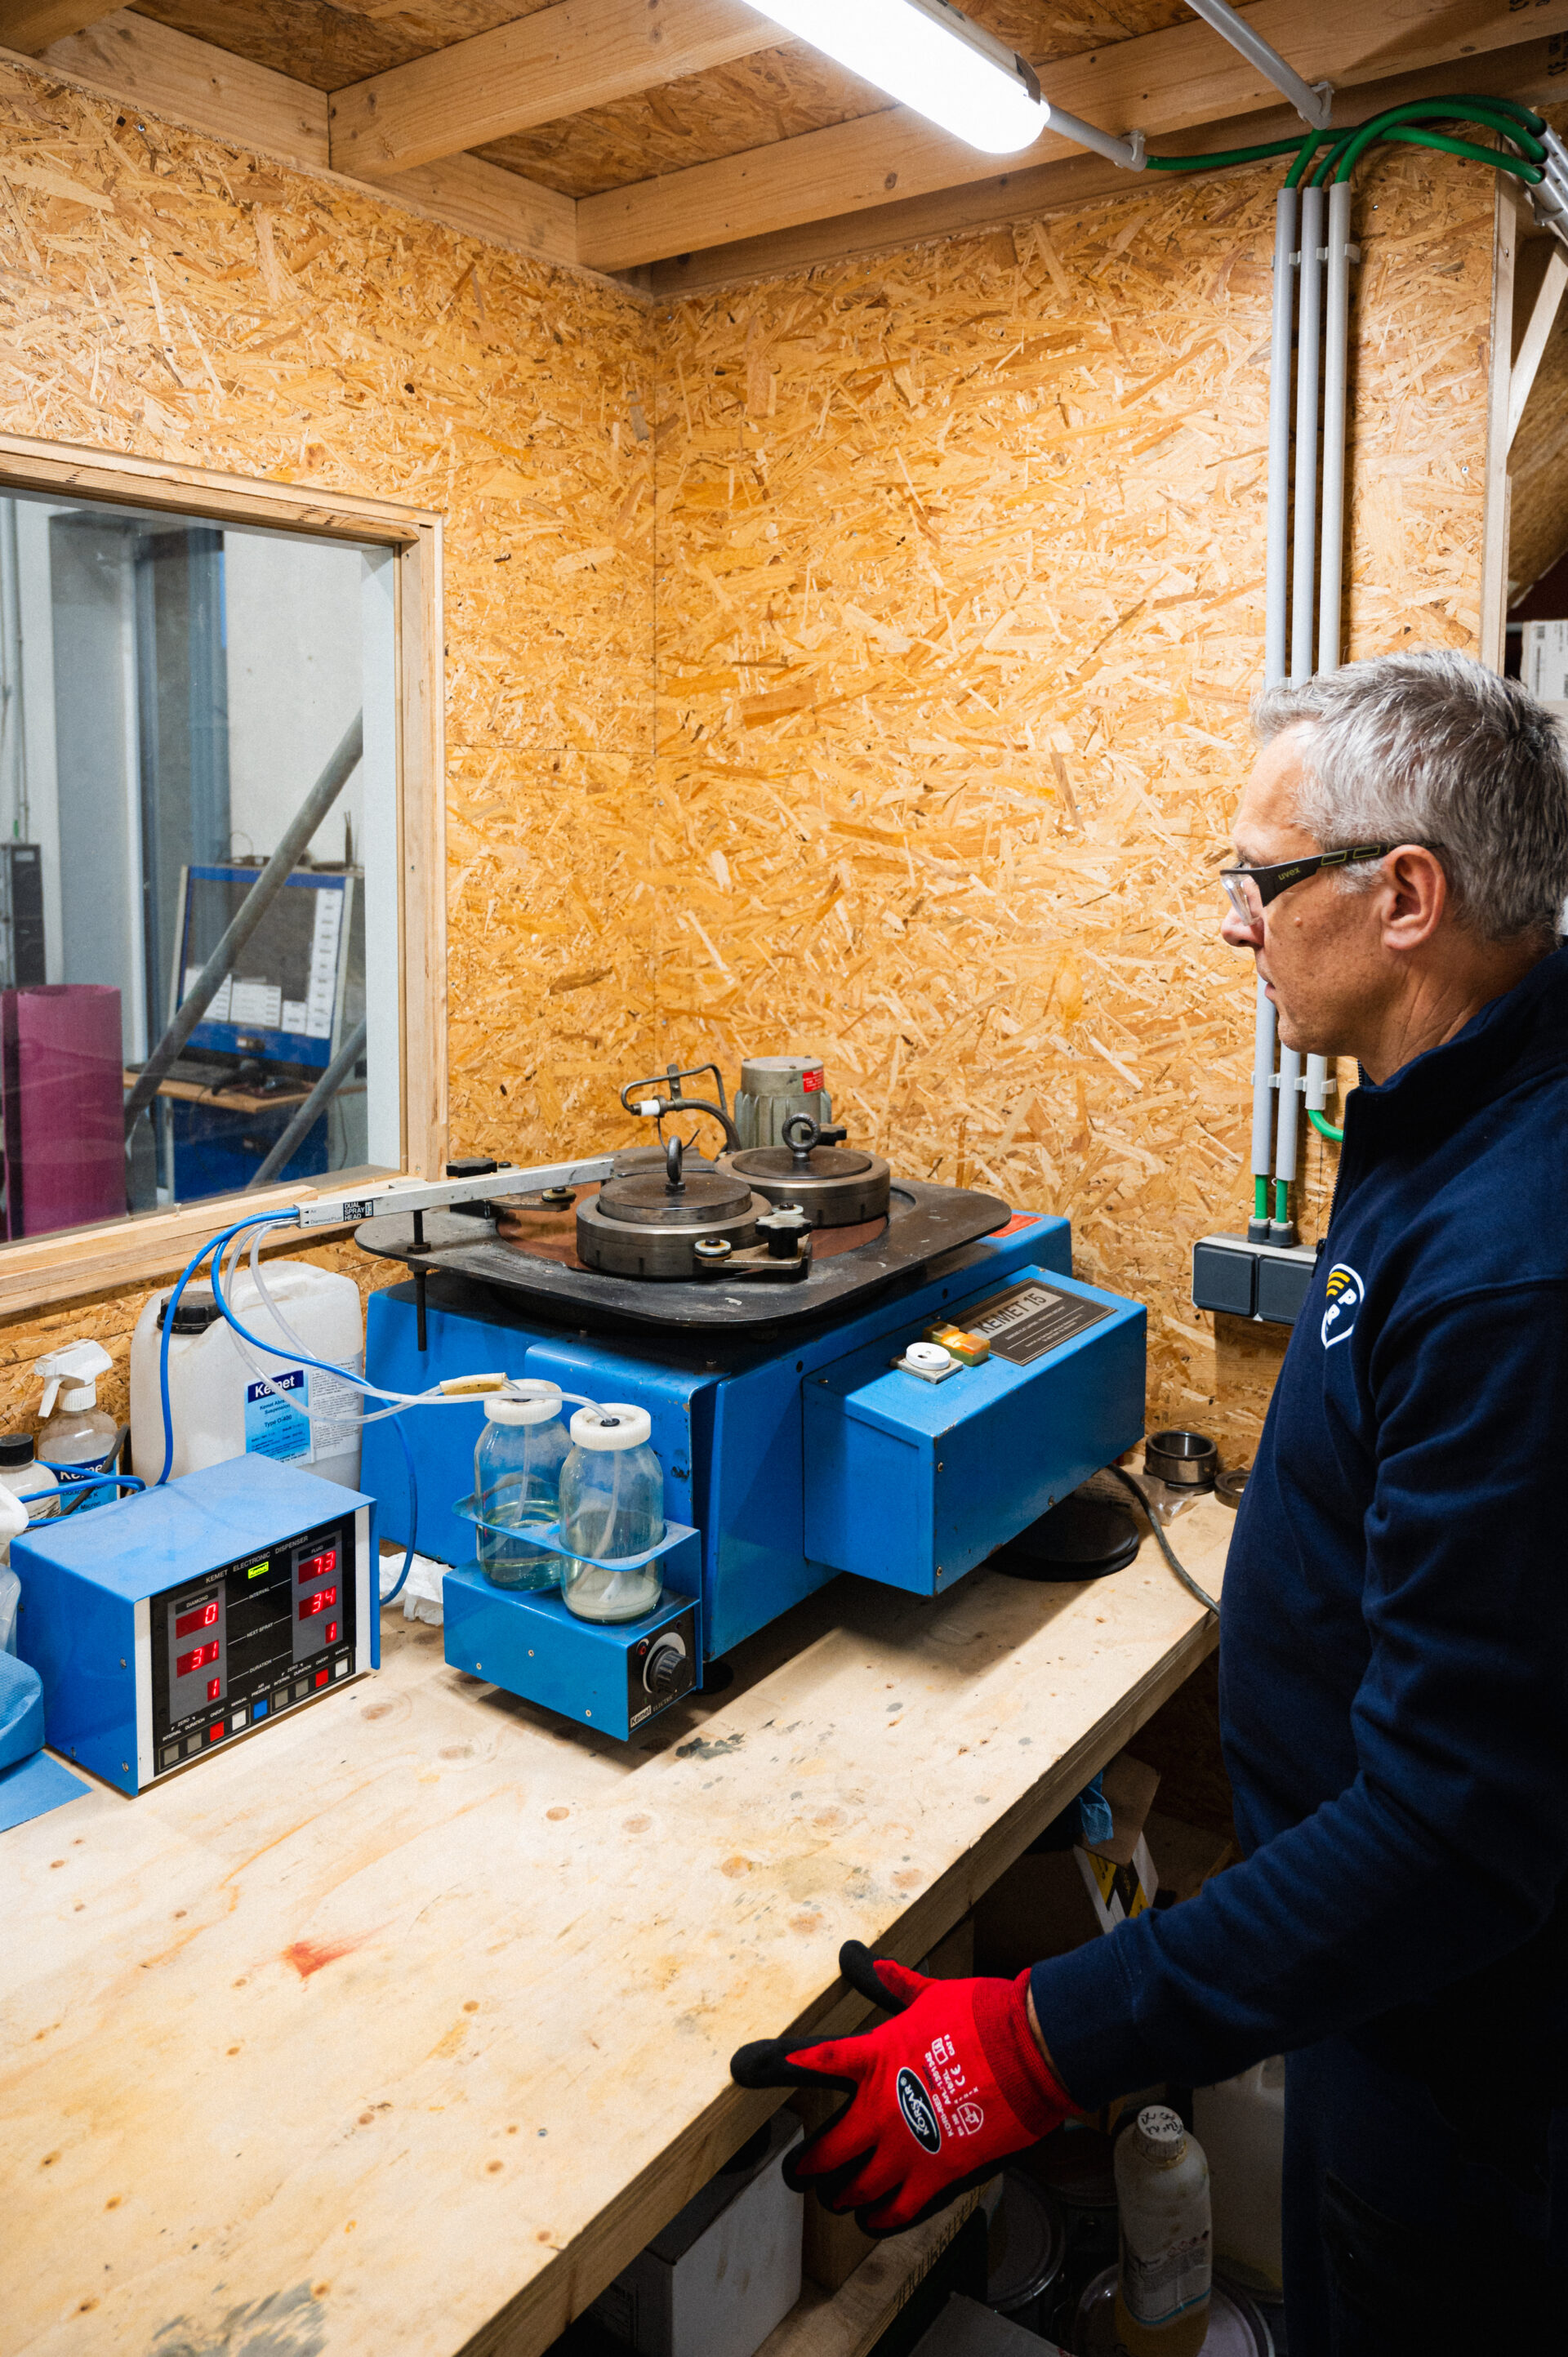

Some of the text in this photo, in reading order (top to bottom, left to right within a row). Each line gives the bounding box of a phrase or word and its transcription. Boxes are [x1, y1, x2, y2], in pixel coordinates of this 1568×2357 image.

[1278, 867, 1301, 880] uvex
[345, 1207, 365, 1215] SPRAY
[973, 1300, 1030, 1334] KEMET
[1023, 1293, 1047, 1307] 15
[264, 1404, 291, 1415] Suspension
[265, 1420, 277, 1428] Type
[80, 1501, 101, 1510] Micron
[311, 1545, 324, 1554] FLUID
[206, 1535, 309, 1584] KEMET ELECTRONIC DISPENSER
[314, 1551, 335, 1574] 73
[248, 1587, 271, 1599] INTERVAL
[186, 1594, 209, 1608] DIAMOND
[312, 1588, 335, 1614] 34
[205, 1602, 217, 1626] 0
[247, 1622, 274, 1638] NEXT SPRAY
[191, 1640, 218, 1670] 31
[335, 1646, 350, 1655] MANUAL
[249, 1659, 273, 1673] DURATION
[287, 1664, 299, 1673] ZERO
[293, 1664, 312, 1677] DURATION
[274, 1675, 291, 1686] INTERVAL
[252, 1684, 271, 1697] PRESSURE
[231, 1696, 247, 1708] MANUAL
[631, 1707, 651, 1724] Kemet
[178, 1718, 190, 1727] ZERO
[185, 1717, 206, 1730] DURATION
[163, 1729, 182, 1742] INTERVAL
[904, 2083, 930, 2136] KORSAR
